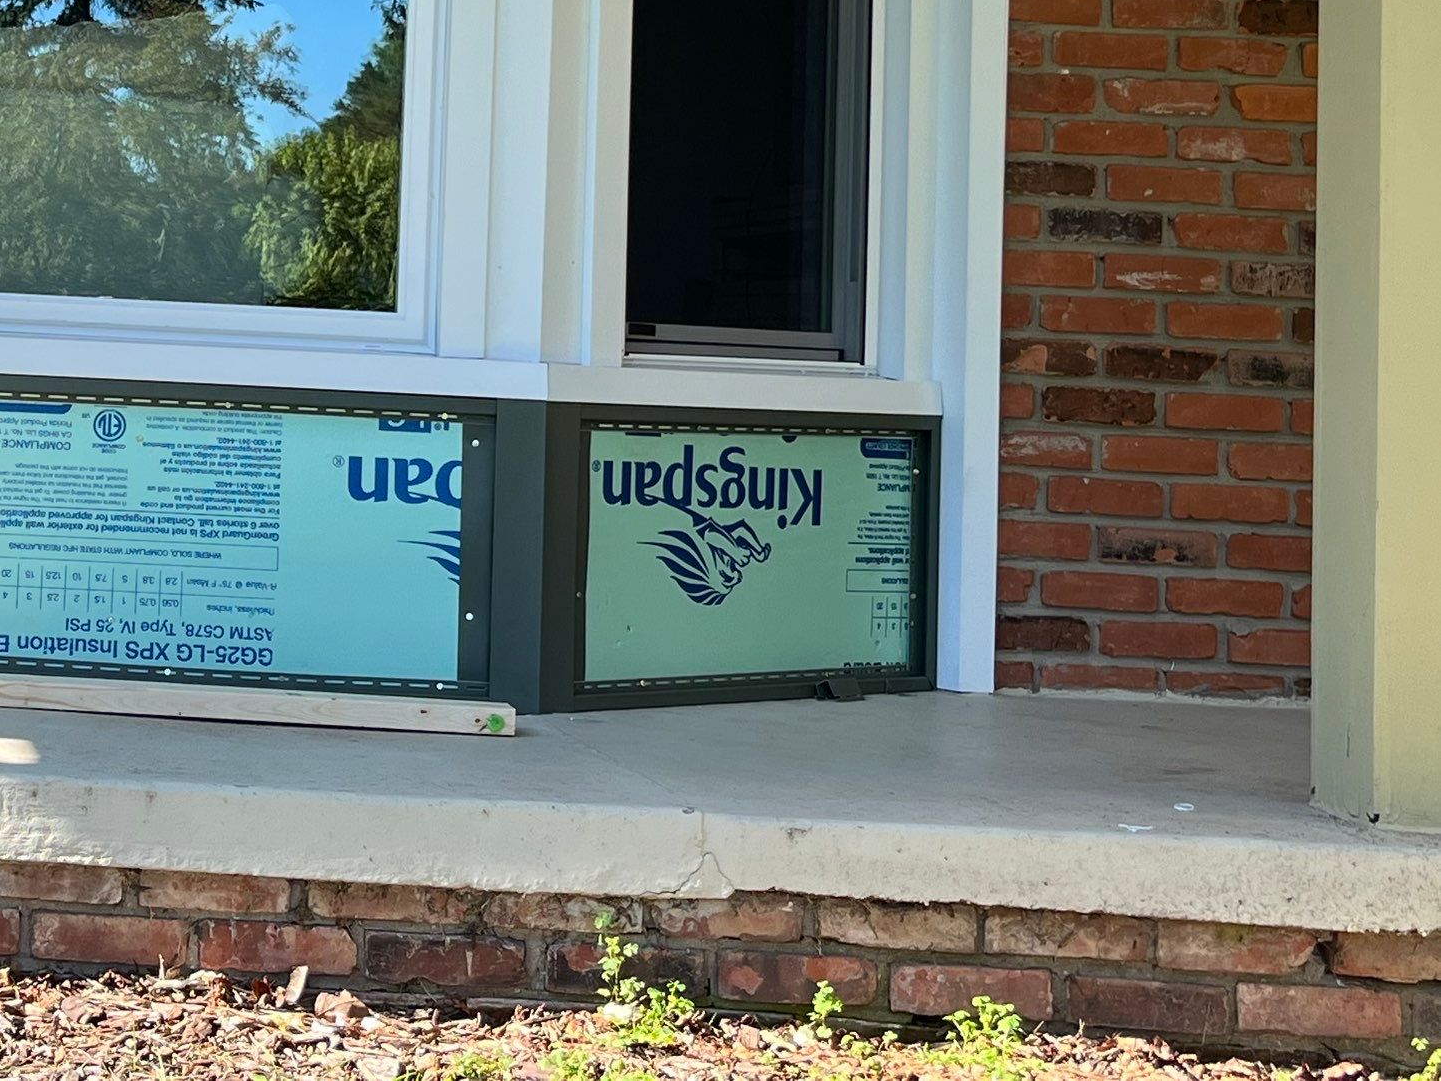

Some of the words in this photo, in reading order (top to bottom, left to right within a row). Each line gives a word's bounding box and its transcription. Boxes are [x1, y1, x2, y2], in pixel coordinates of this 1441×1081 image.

[1, 438, 71, 451] COMPLIANCE
[603, 445, 822, 530] Kingspan
[48, 509, 93, 521] approved
[95, 514, 108, 522] for
[110, 512, 155, 524] Kingspan
[26, 521, 44, 530] wall
[157, 516, 195, 527] Contact
[216, 519, 249, 529] stories
[250, 521, 257, 530] 6
[47, 522, 83, 531] exterior
[85, 524, 99, 533] for
[101, 524, 169, 536] recommended
[171, 527, 187, 536] not
[190, 528, 197, 537] is
[200, 529, 220, 538] XPS
[222, 530, 279, 542] GreenGuard
[1, 569, 12, 577] 20
[25, 570, 34, 579] 15
[45, 571, 61, 580] 12.5
[72, 572, 82, 581] 10
[95, 574, 107, 582] 7.5
[122, 575, 128, 583] 5
[142, 576, 155, 584] 3.8
[165, 577, 178, 585] 2.8
[2, 591, 9, 599] 4
[26, 592, 32, 600] 3
[47, 593, 59, 601] 2.5
[74, 594, 80, 602] 2
[94, 595, 105, 603] 1.5
[139, 598, 156, 606] 0.75
[162, 599, 179, 607] 0.56
[65, 618, 90, 632] PSI
[96, 618, 114, 632] 25
[119, 618, 135, 634] IV,
[140, 618, 176, 636] Type
[181, 621, 224, 639] C578,
[230, 626, 274, 641] ASTM
[17, 635, 118, 658] Insulation
[125, 640, 170, 661] XPS
[176, 643, 273, 667] GG25-LG
